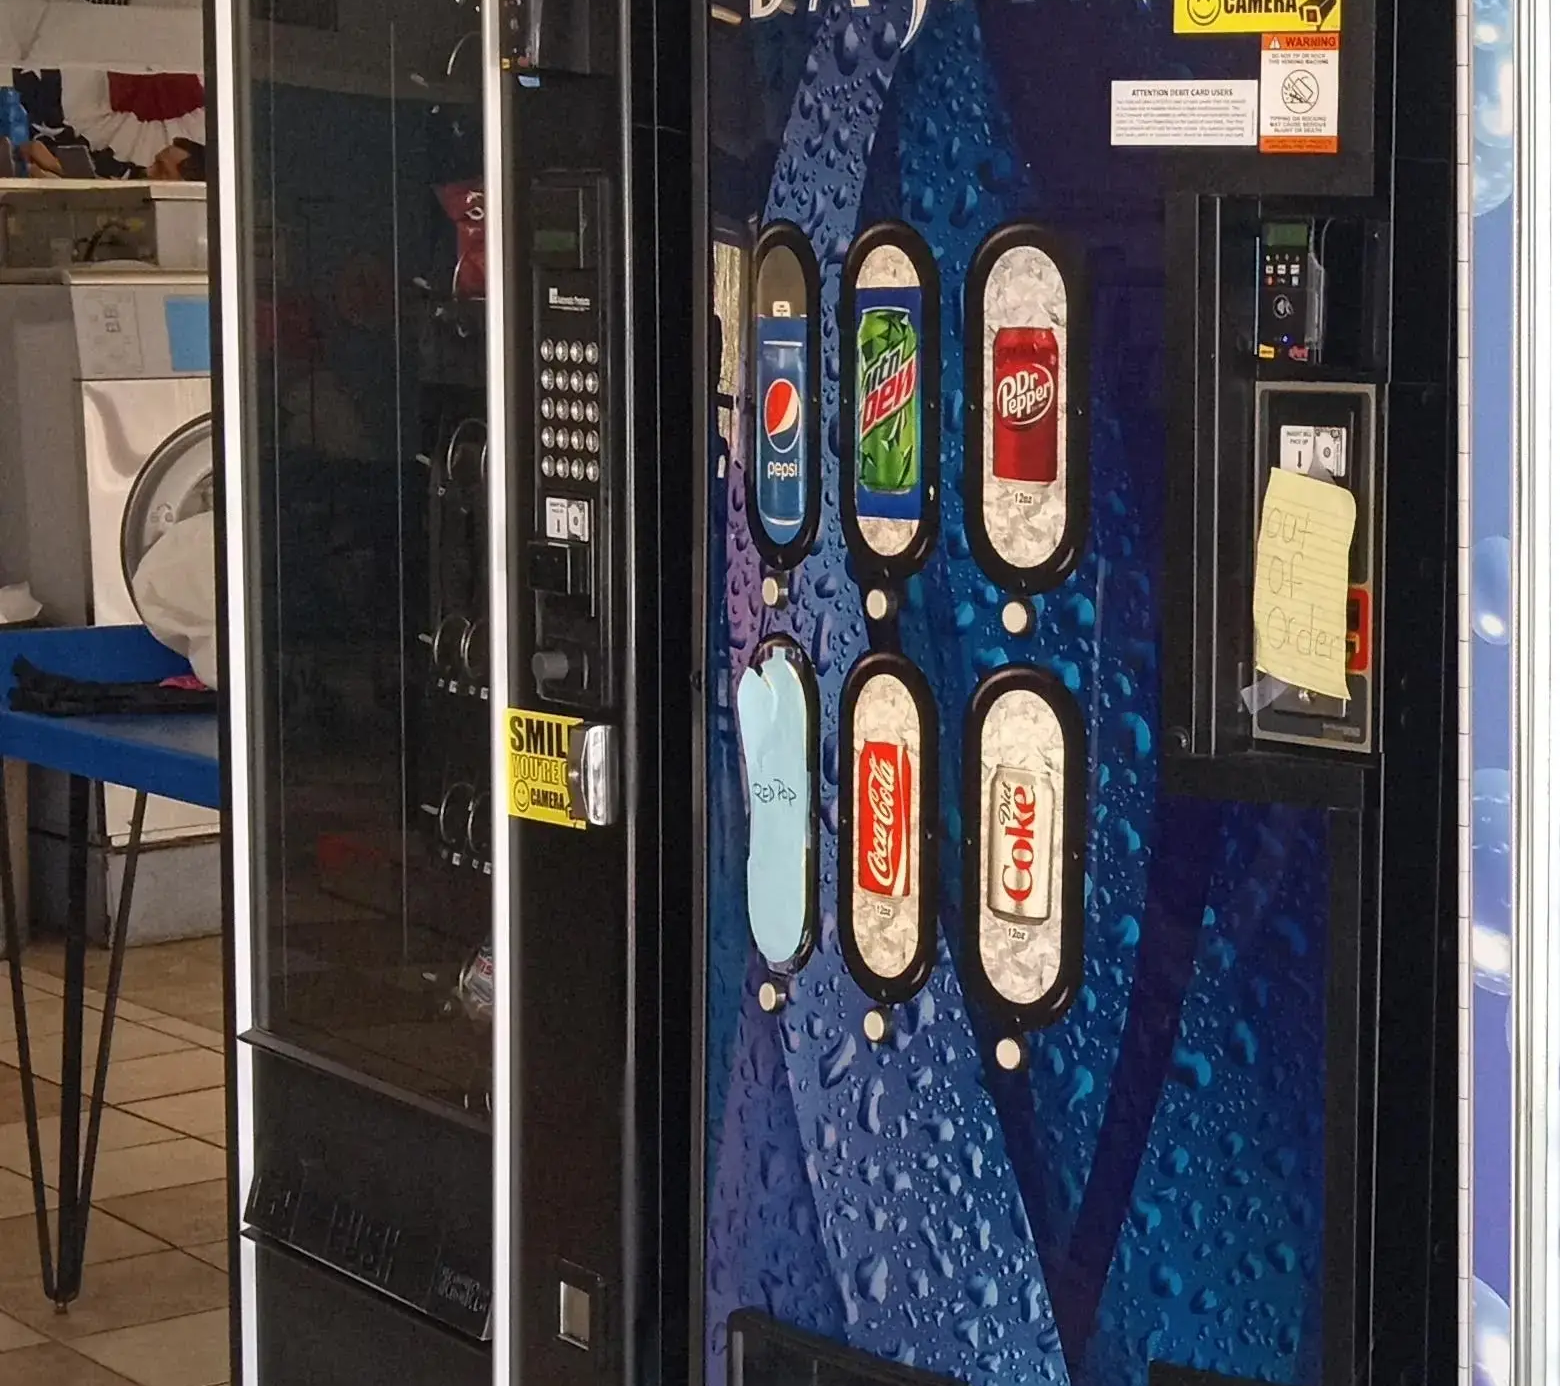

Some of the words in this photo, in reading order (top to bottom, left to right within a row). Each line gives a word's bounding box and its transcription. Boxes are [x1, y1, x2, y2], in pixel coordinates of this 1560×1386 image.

[1285, 37, 1336, 47] WARNING
[1132, 88, 1168, 97] ATTENTION
[1002, 376, 1051, 419] Pepper
[1016, 371, 1038, 396] Dr
[767, 459, 798, 482] pepsi
[509, 715, 569, 758] SMIL
[512, 754, 559, 785] YOU'RE
[531, 788, 564, 811] CAMERA
[1000, 782, 1012, 825] Diet
[1002, 784, 1036, 902] Coke
